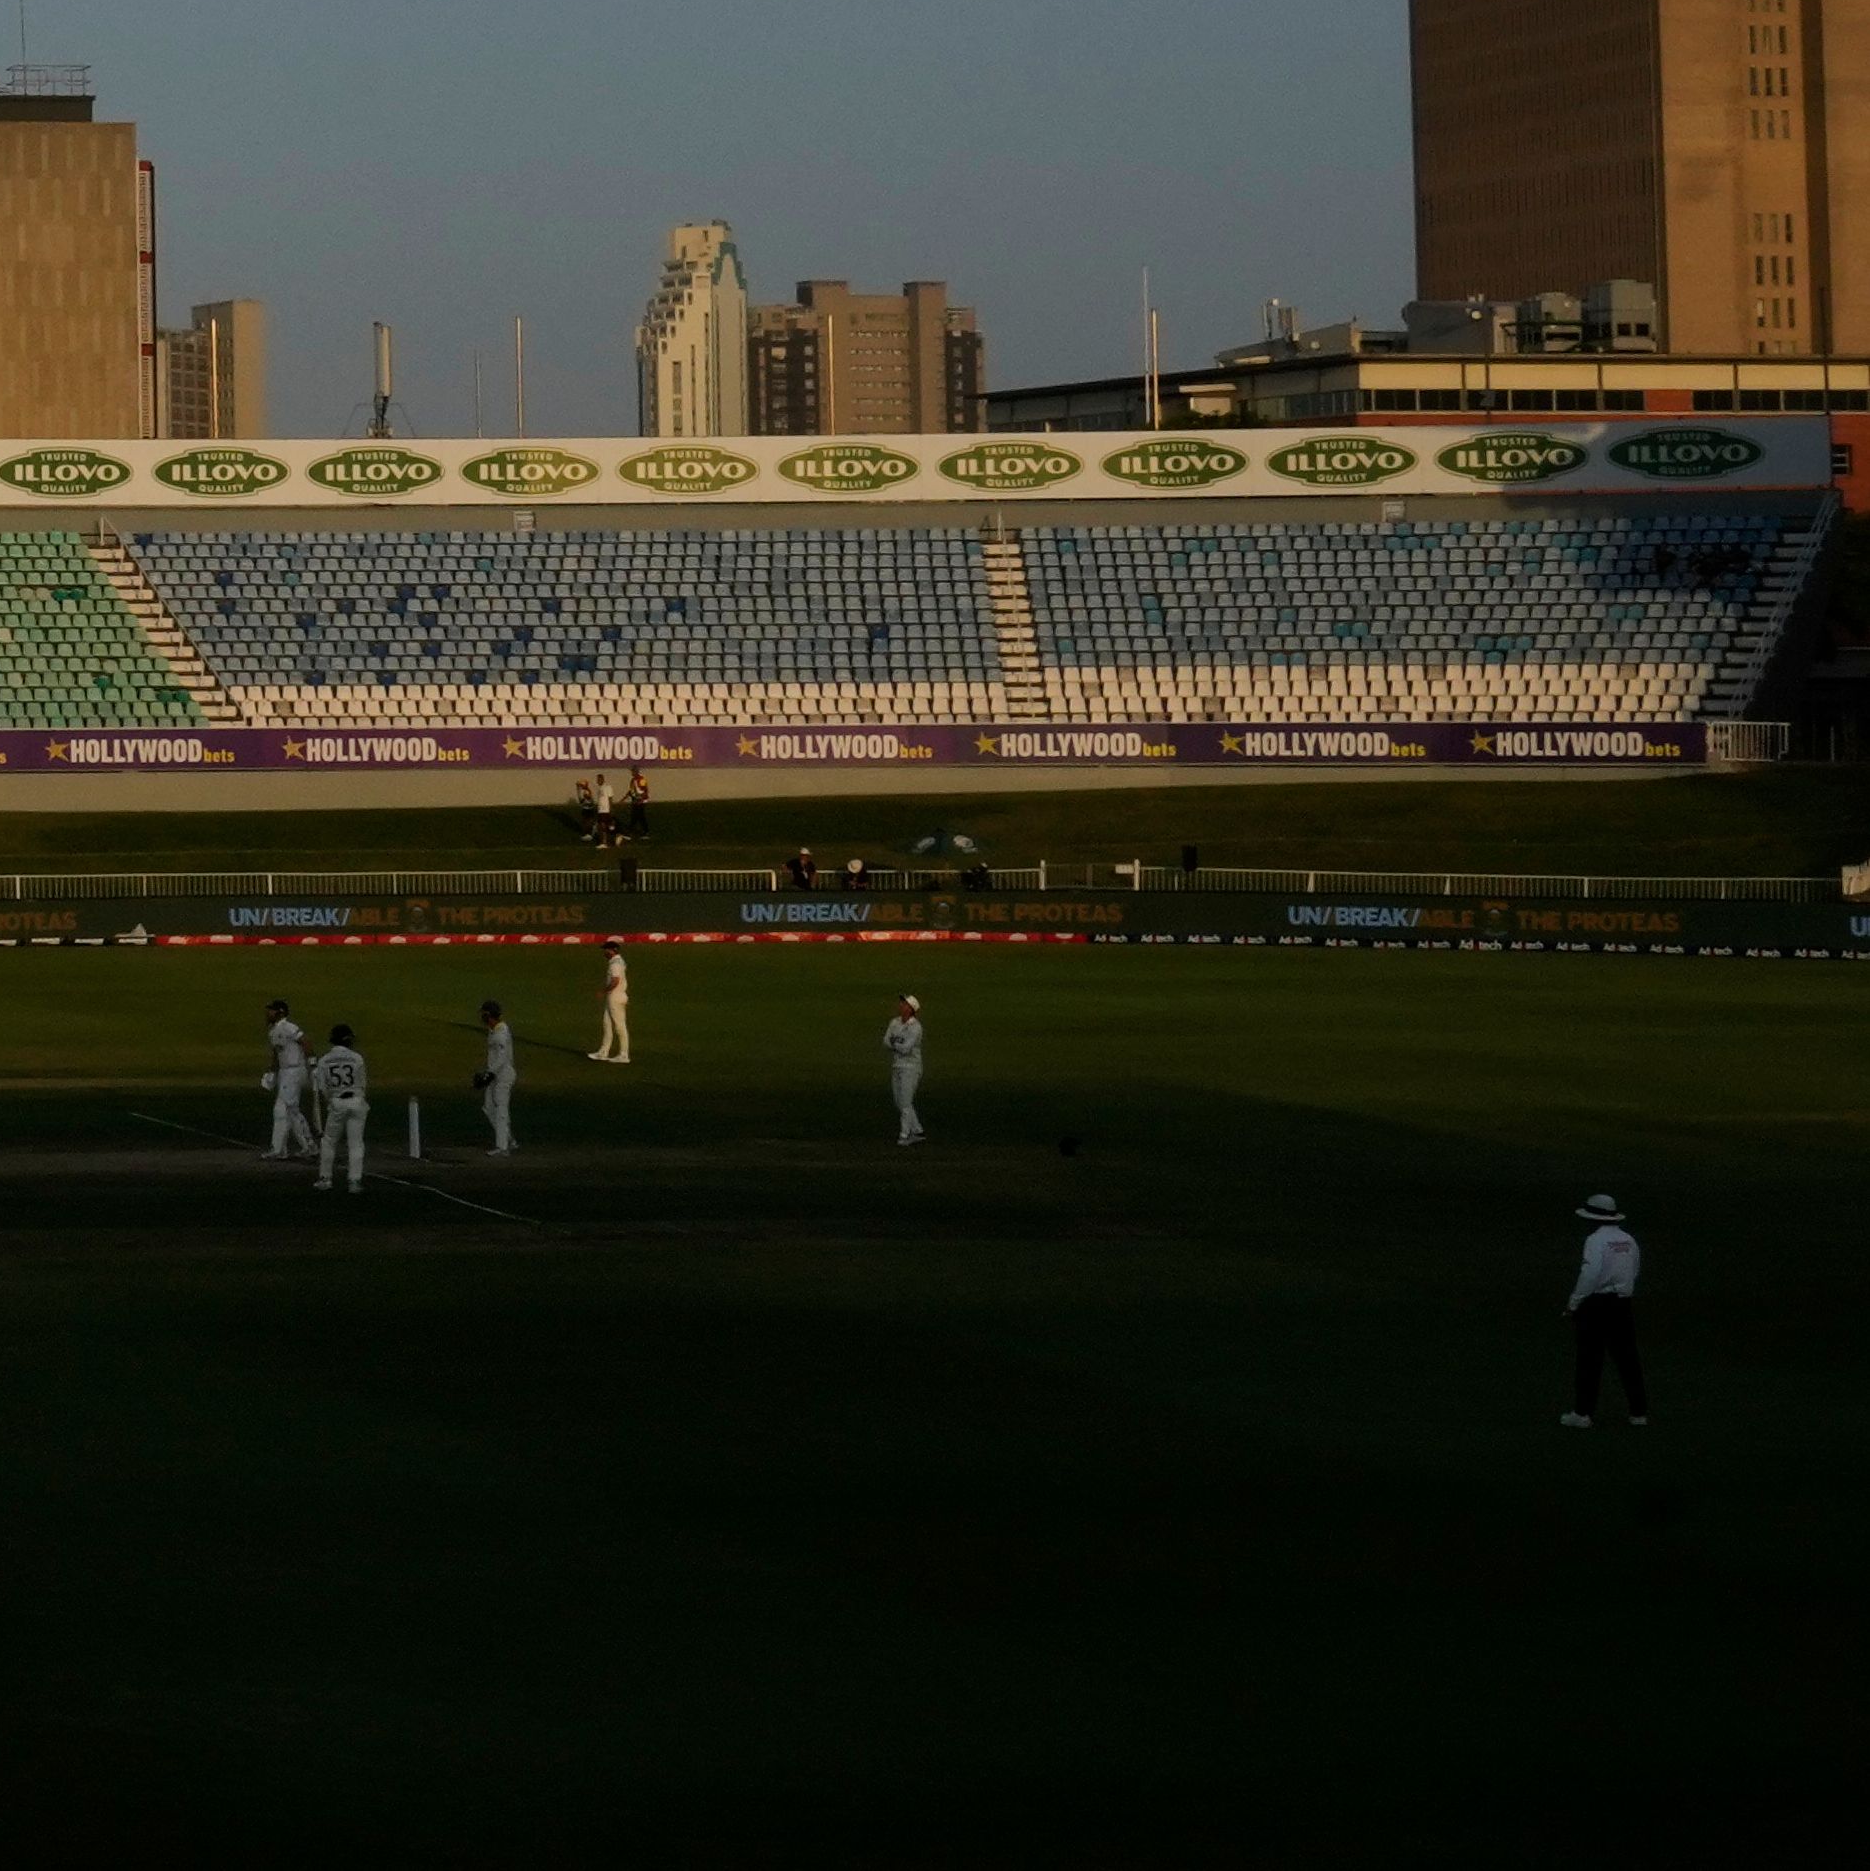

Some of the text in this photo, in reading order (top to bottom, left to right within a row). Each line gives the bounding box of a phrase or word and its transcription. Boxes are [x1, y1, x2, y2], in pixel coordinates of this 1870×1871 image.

[795, 459, 907, 477] ILLOVO
[957, 457, 1070, 475] ILLOVO
[1120, 455, 1235, 473] ILLOVO
[1287, 452, 1404, 471] ILLOVO
[1456, 449, 1575, 468] ILLOVO
[14, 462, 121, 482] ILLOVO
[172, 462, 279, 482] ILLOVO
[325, 462, 432, 482] ILLOVO
[479, 462, 587, 482] ILLOVO
[636, 462, 745, 482] ILLOVO
[70, 738, 235, 763] HOLLYWOODbets
[306, 737, 470, 763] HOLLYWOODbets
[526, 736, 694, 761] HOLLYWOODbets
[761, 734, 933, 760] HOLLYWOODbets
[1001, 733, 1177, 758] HOLLYWOODbets
[1246, 732, 1427, 758] HOLLYWOODbets
[1496, 732, 1681, 757] HOLLYWOODbets
[327, 1064, 354, 1088] 53
